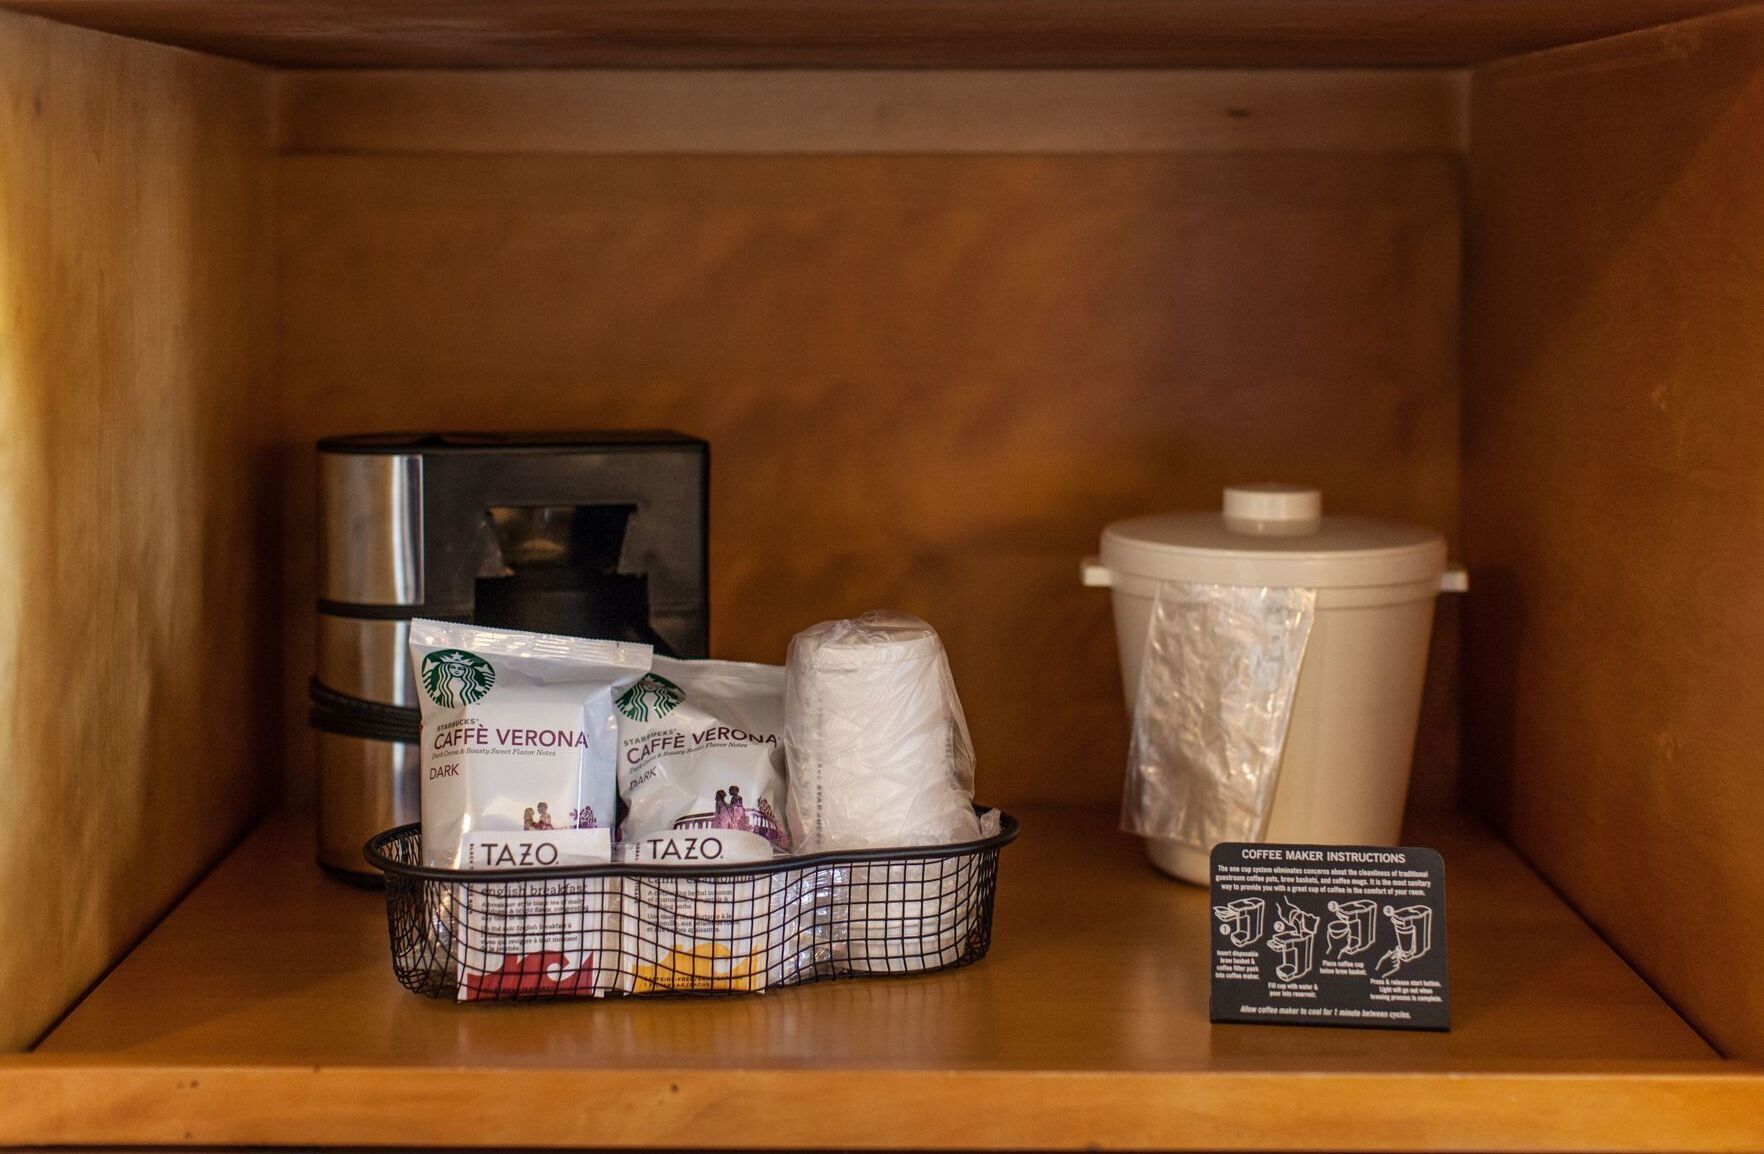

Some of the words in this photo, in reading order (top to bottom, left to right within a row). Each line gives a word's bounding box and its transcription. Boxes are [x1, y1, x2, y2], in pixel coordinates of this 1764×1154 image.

[437, 718, 475, 732] STARBUCKS
[434, 724, 488, 750] CAFFÈ
[496, 728, 588, 749] VERONA
[624, 729, 674, 747] STARBUCKS
[627, 733, 685, 764] CAFFÈ
[692, 727, 777, 748] VERONA
[429, 763, 459, 780] DARK
[629, 766, 656, 791] DARK
[1242, 849, 1282, 860] COFFEE
[1285, 850, 1323, 861] MAKER
[1327, 851, 1406, 864] INSTRUCTIONS
[1252, 866, 1272, 874] system
[1240, 884, 1261, 892] provide
[1240, 1005, 1257, 1013] Allow
[1258, 1006, 1278, 1014] coffee
[1308, 1008, 1322, 1016] cool
[1323, 1008, 1333, 1016] for
[1340, 1009, 1361, 1017] minute
[1362, 1009, 1388, 1018] between
